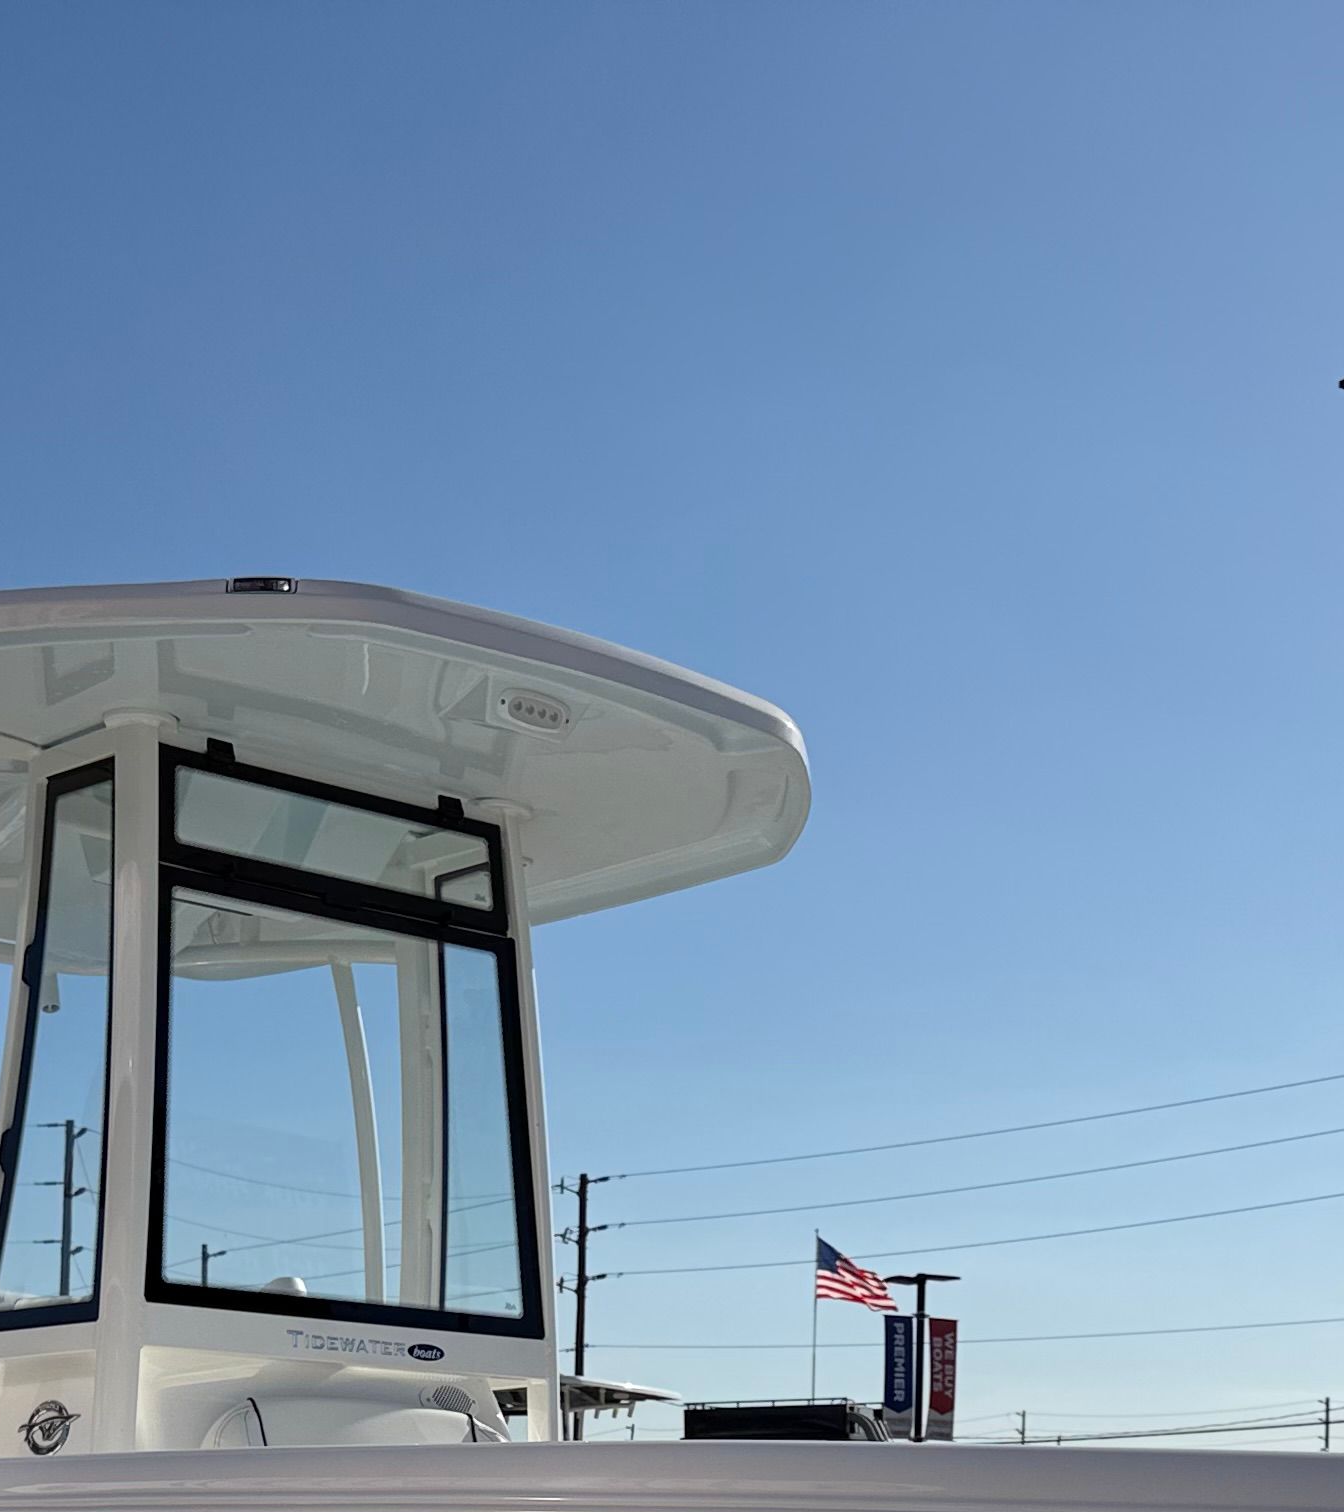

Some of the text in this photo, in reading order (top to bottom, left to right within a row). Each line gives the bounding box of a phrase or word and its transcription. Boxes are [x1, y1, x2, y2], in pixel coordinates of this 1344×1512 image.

[286, 1329, 442, 1361] TIDEWATER boats
[894, 1322, 906, 1402] PREMIER
[932, 1337, 943, 1392] BOATS
[944, 1332, 954, 1398] WE BUY
